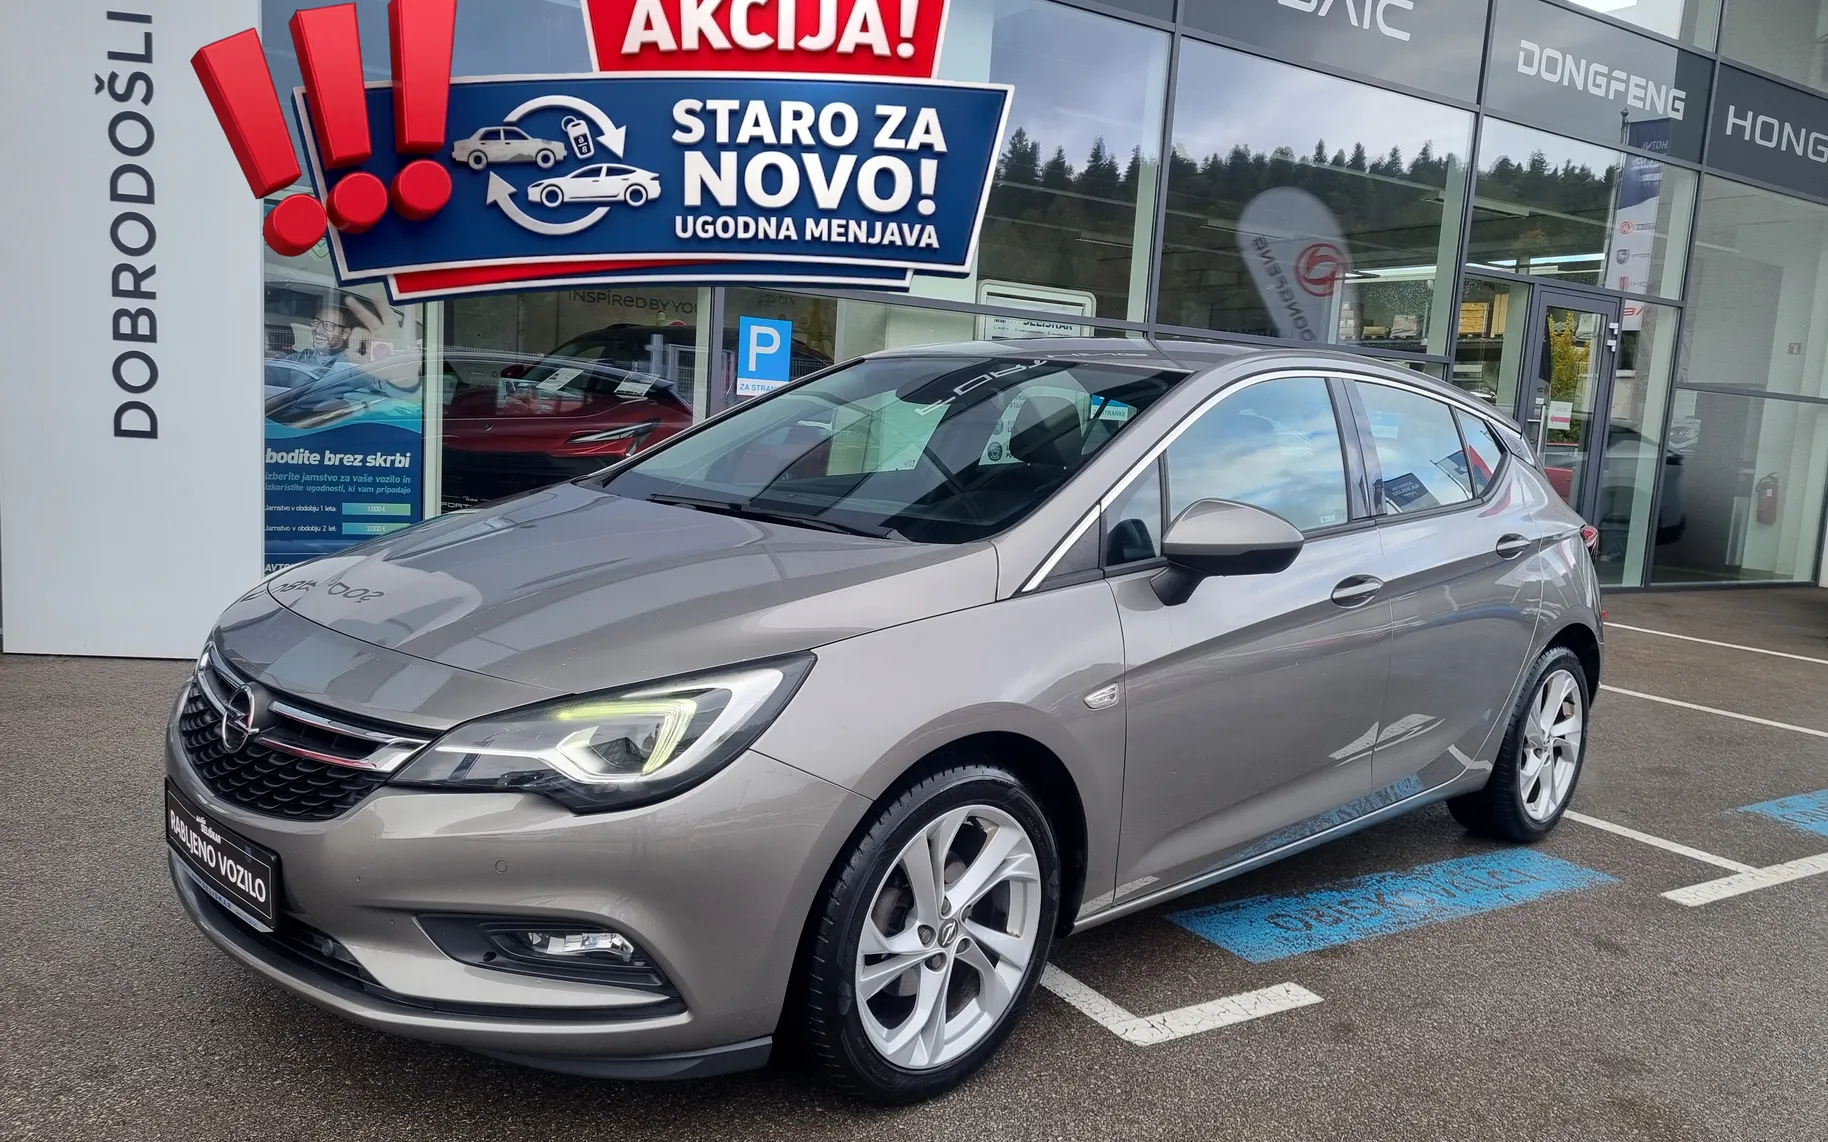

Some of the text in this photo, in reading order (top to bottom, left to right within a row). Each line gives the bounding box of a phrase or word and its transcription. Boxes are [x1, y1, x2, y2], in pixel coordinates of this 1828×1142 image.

[1517, 39, 1687, 121] DONGFENG
[1725, 104, 1828, 163] HONG
[95, 10, 159, 439] DOBRODOŠLI
[649, 298, 670, 312] BY
[671, 301, 698, 314] YO
[749, 325, 781, 372] P
[265, 448, 411, 468] bodite brez skrbi
[265, 471, 300, 481] izberite
[301, 472, 338, 483] jamstvo
[352, 473, 374, 483] vaše
[375, 475, 401, 484] vozilo
[402, 475, 411, 484] in
[265, 483, 304, 491] izkoristite
[306, 484, 346, 493] ugodnosti,
[348, 484, 356, 493] ki
[375, 486, 411, 495] pripadajo
[265, 504, 291, 512] Jamstvo
[296, 504, 320, 513] obdobju
[265, 524, 291, 532] Jamstvo
[297, 524, 321, 533] obdobju
[170, 809, 266, 903] RABLJENO VOZILO
